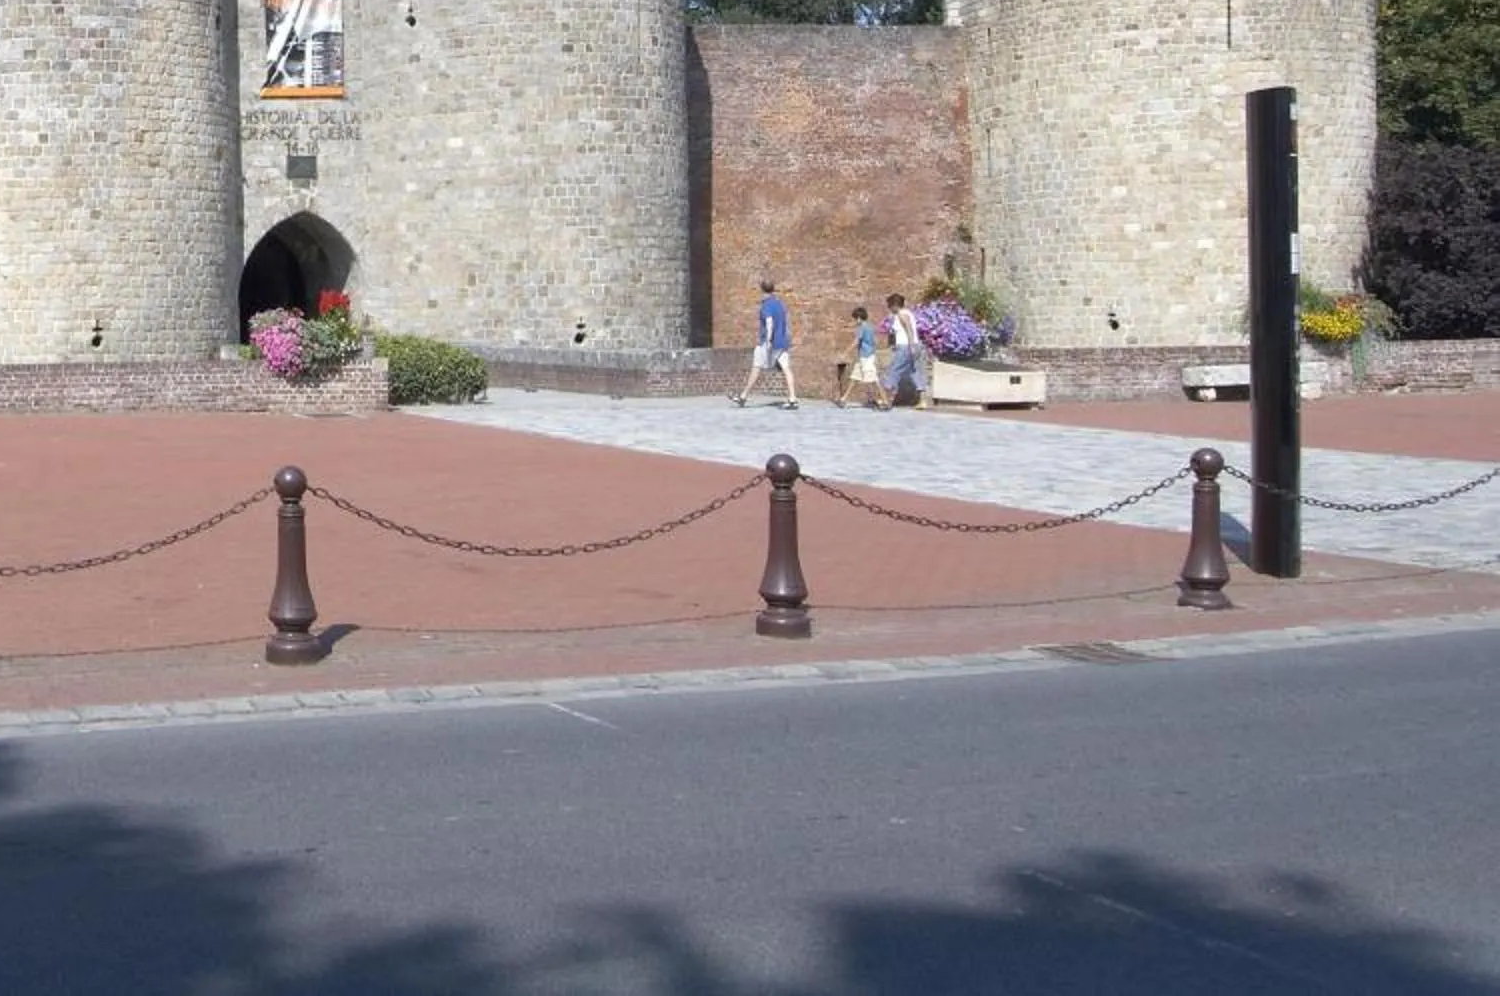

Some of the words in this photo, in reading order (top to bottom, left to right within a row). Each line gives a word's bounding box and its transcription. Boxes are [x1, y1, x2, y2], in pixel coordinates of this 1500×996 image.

[240, 111, 309, 125] HISTORIAL
[318, 111, 337, 125] DE
[343, 111, 361, 125] LA
[240, 126, 301, 140] GRANDE
[308, 126, 362, 141] GUERRE
